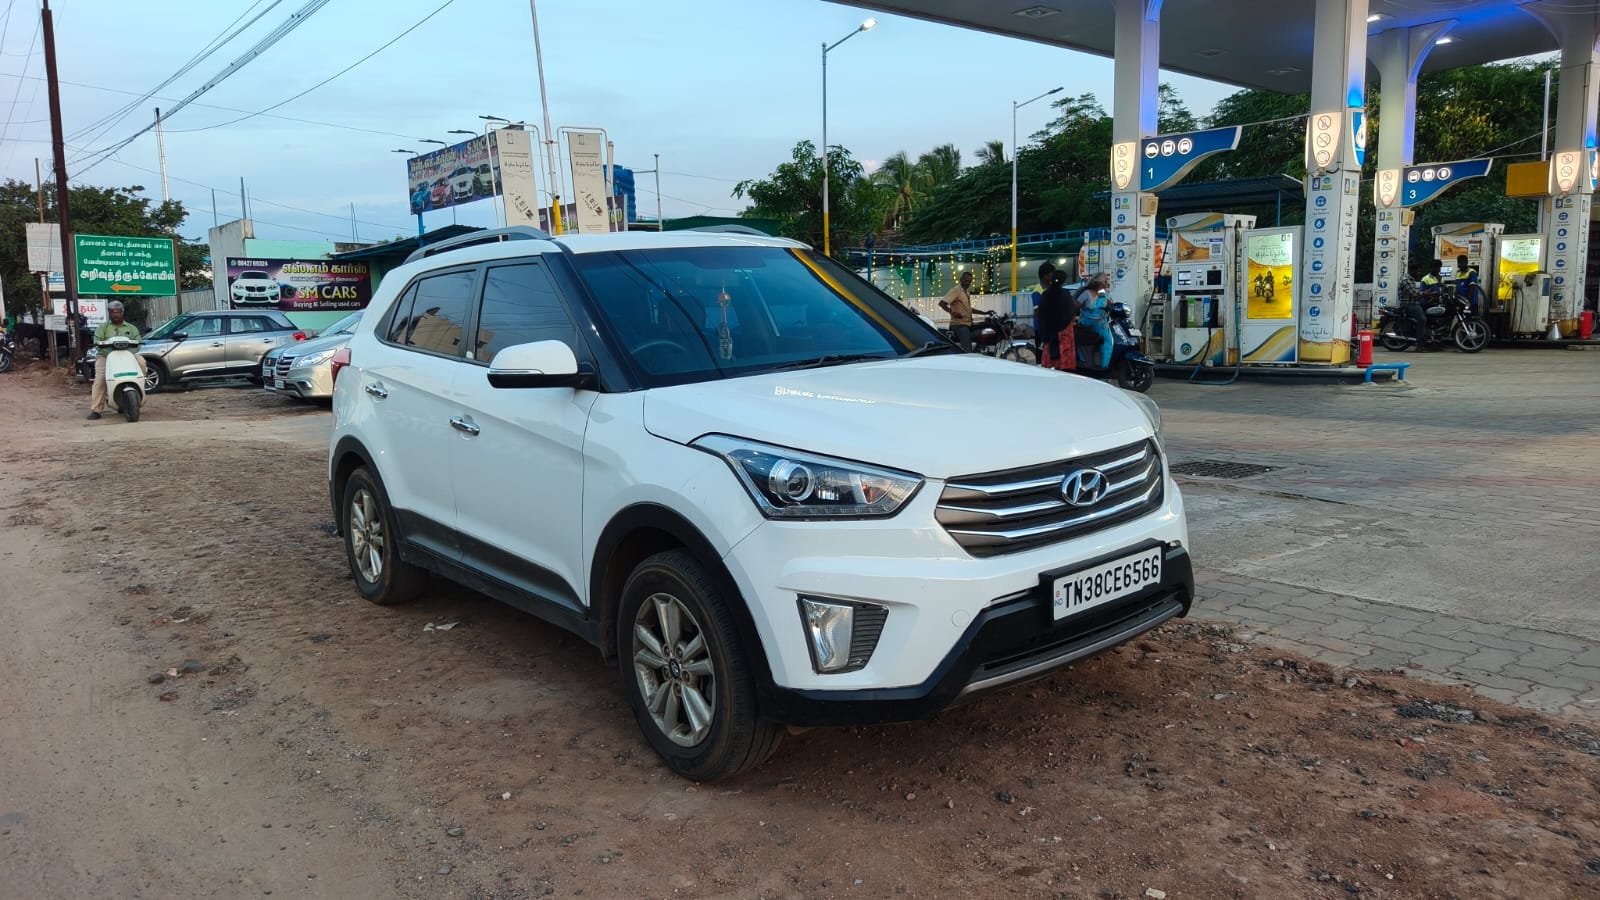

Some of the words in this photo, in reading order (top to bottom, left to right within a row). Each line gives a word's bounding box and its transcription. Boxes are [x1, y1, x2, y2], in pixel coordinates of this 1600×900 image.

[1148, 167, 1153, 179] 1
[1409, 190, 1416, 199] 3
[80, 268, 175, 281] அறிவுத்திருக்கோயில்
[298, 287, 318, 299] SM
[322, 286, 357, 299] CARS
[293, 301, 312, 309] Buying
[1063, 554, 1159, 608] TN38CE6566
